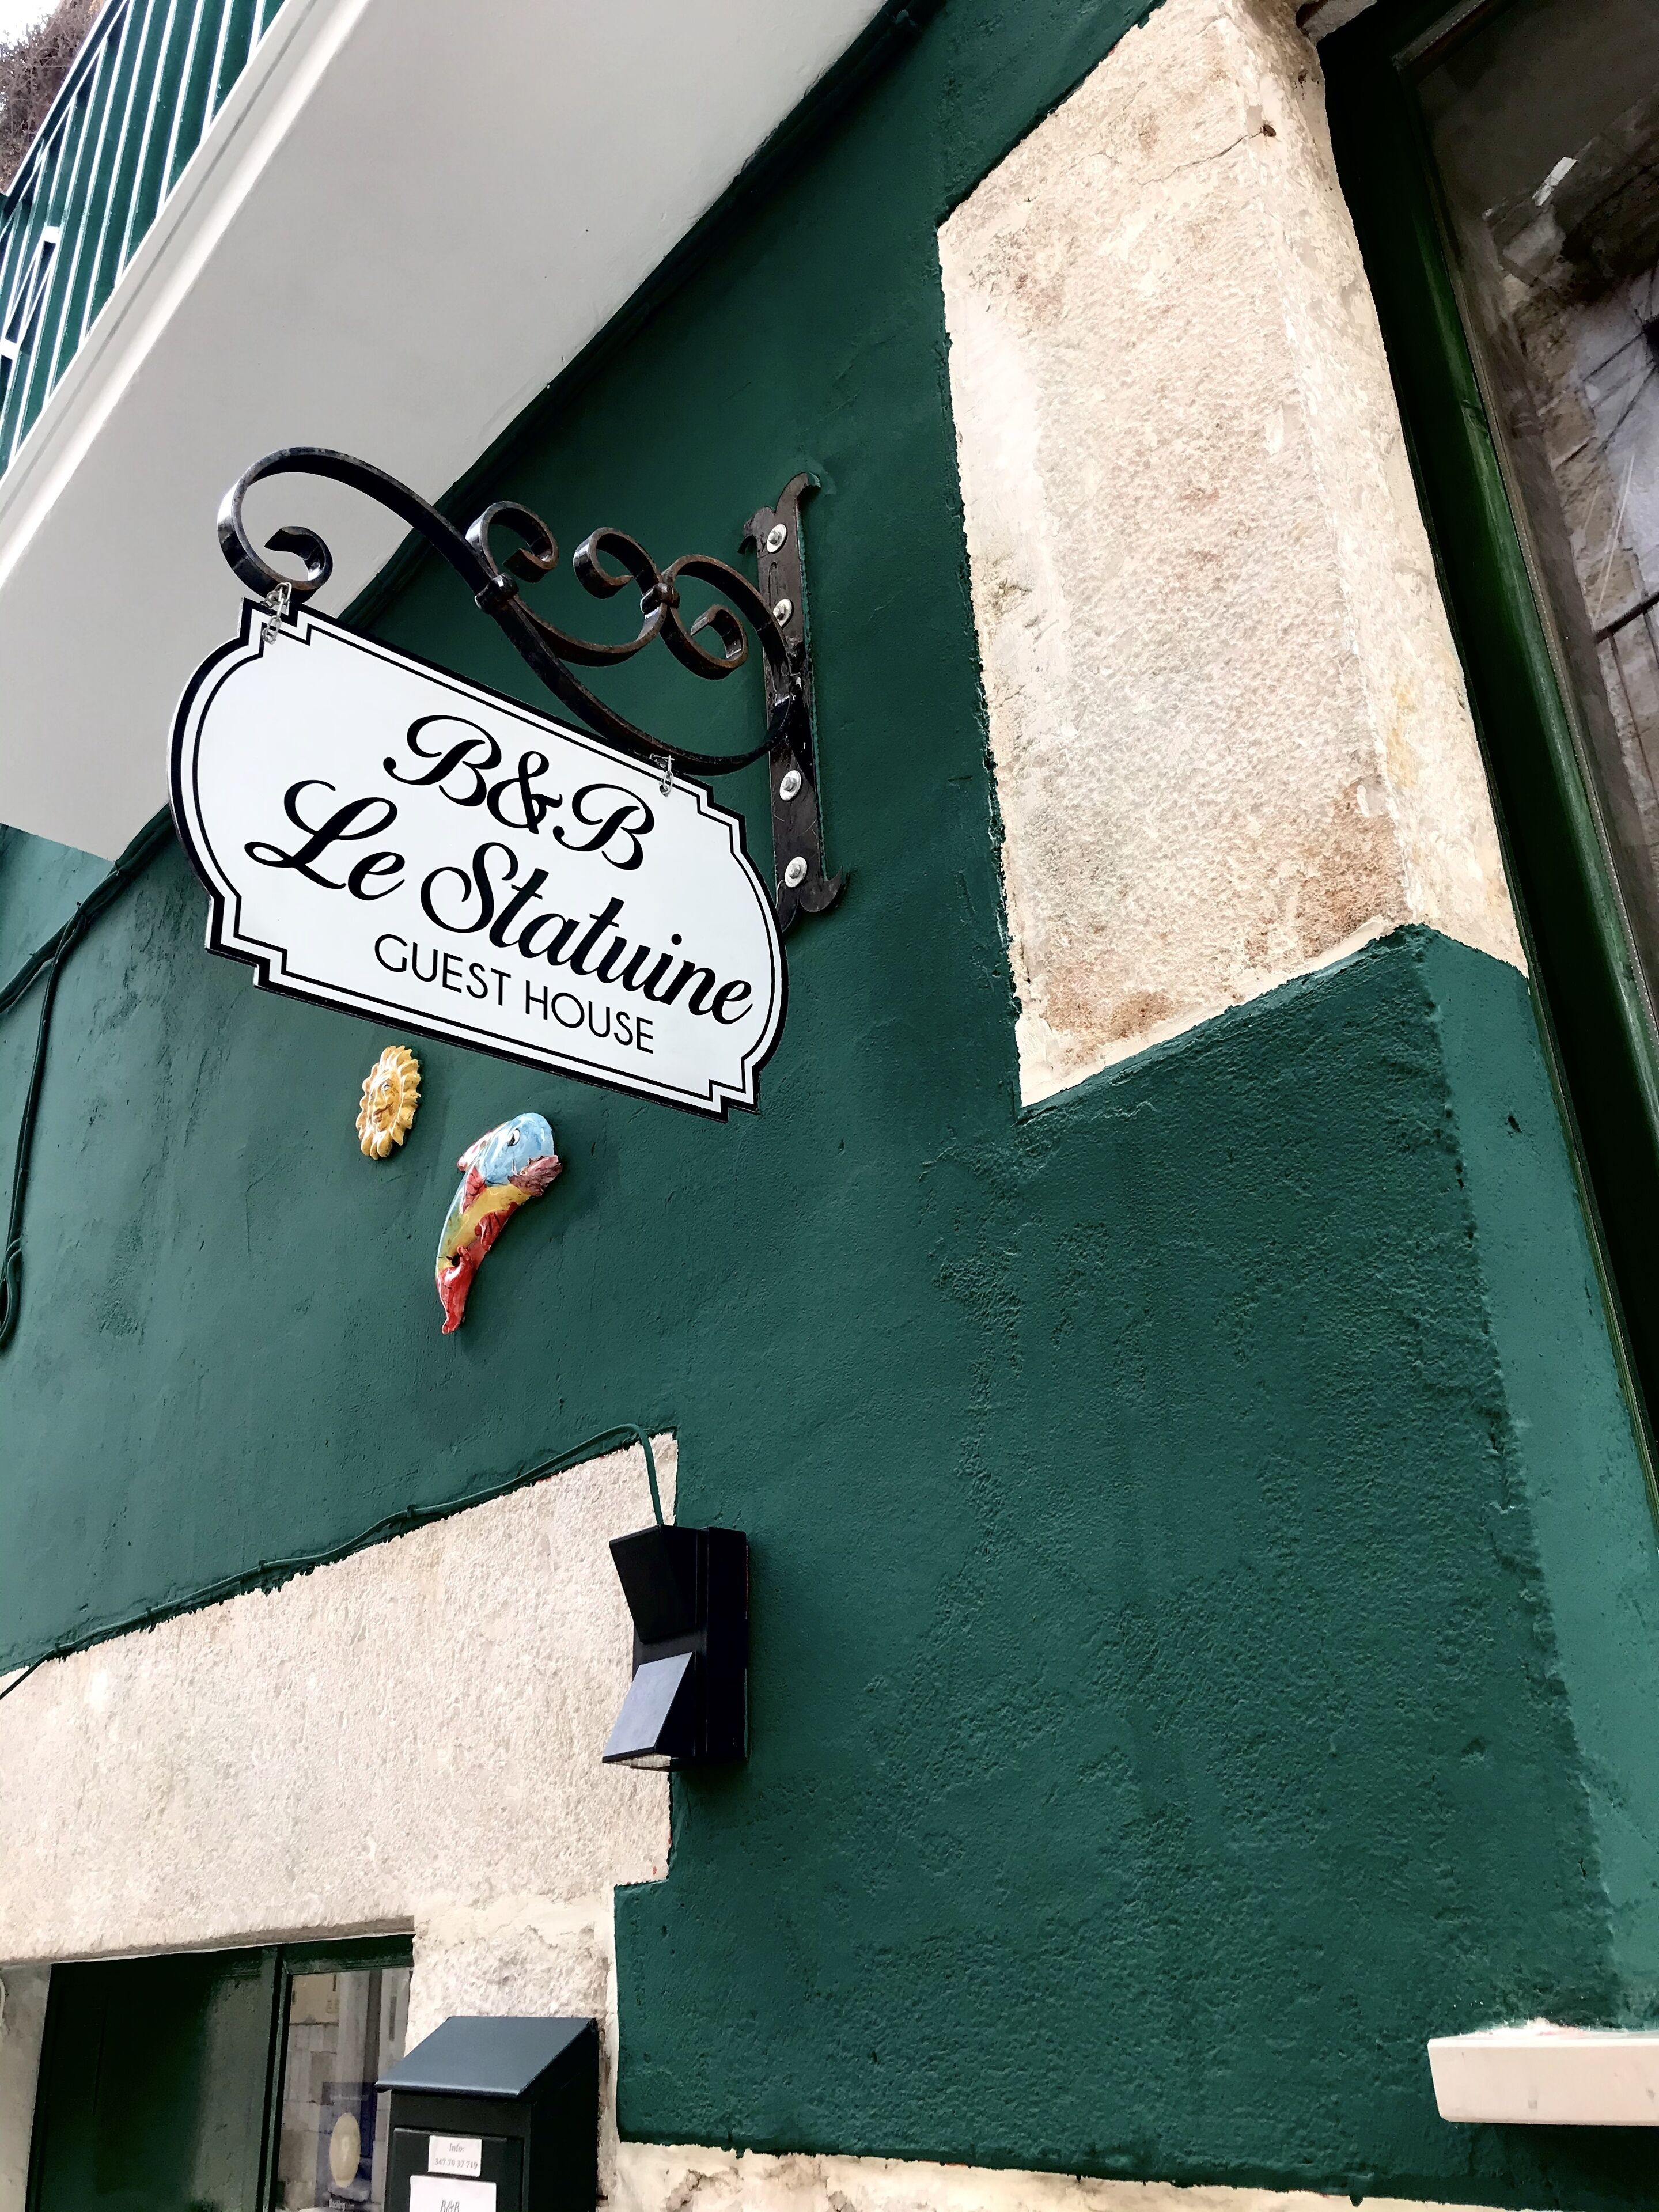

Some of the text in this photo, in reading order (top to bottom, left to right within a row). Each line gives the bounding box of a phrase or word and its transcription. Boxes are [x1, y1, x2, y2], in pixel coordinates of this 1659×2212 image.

[382, 715, 655, 871] B&B
[244, 779, 753, 1025] Le Statuine
[374, 934, 654, 1054] GUEST HOUSE
[435, 2158, 478, 2169] 347 70 37 719
[449, 2143, 464, 2153] Info:
[440, 2200, 460, 2212] B&B
